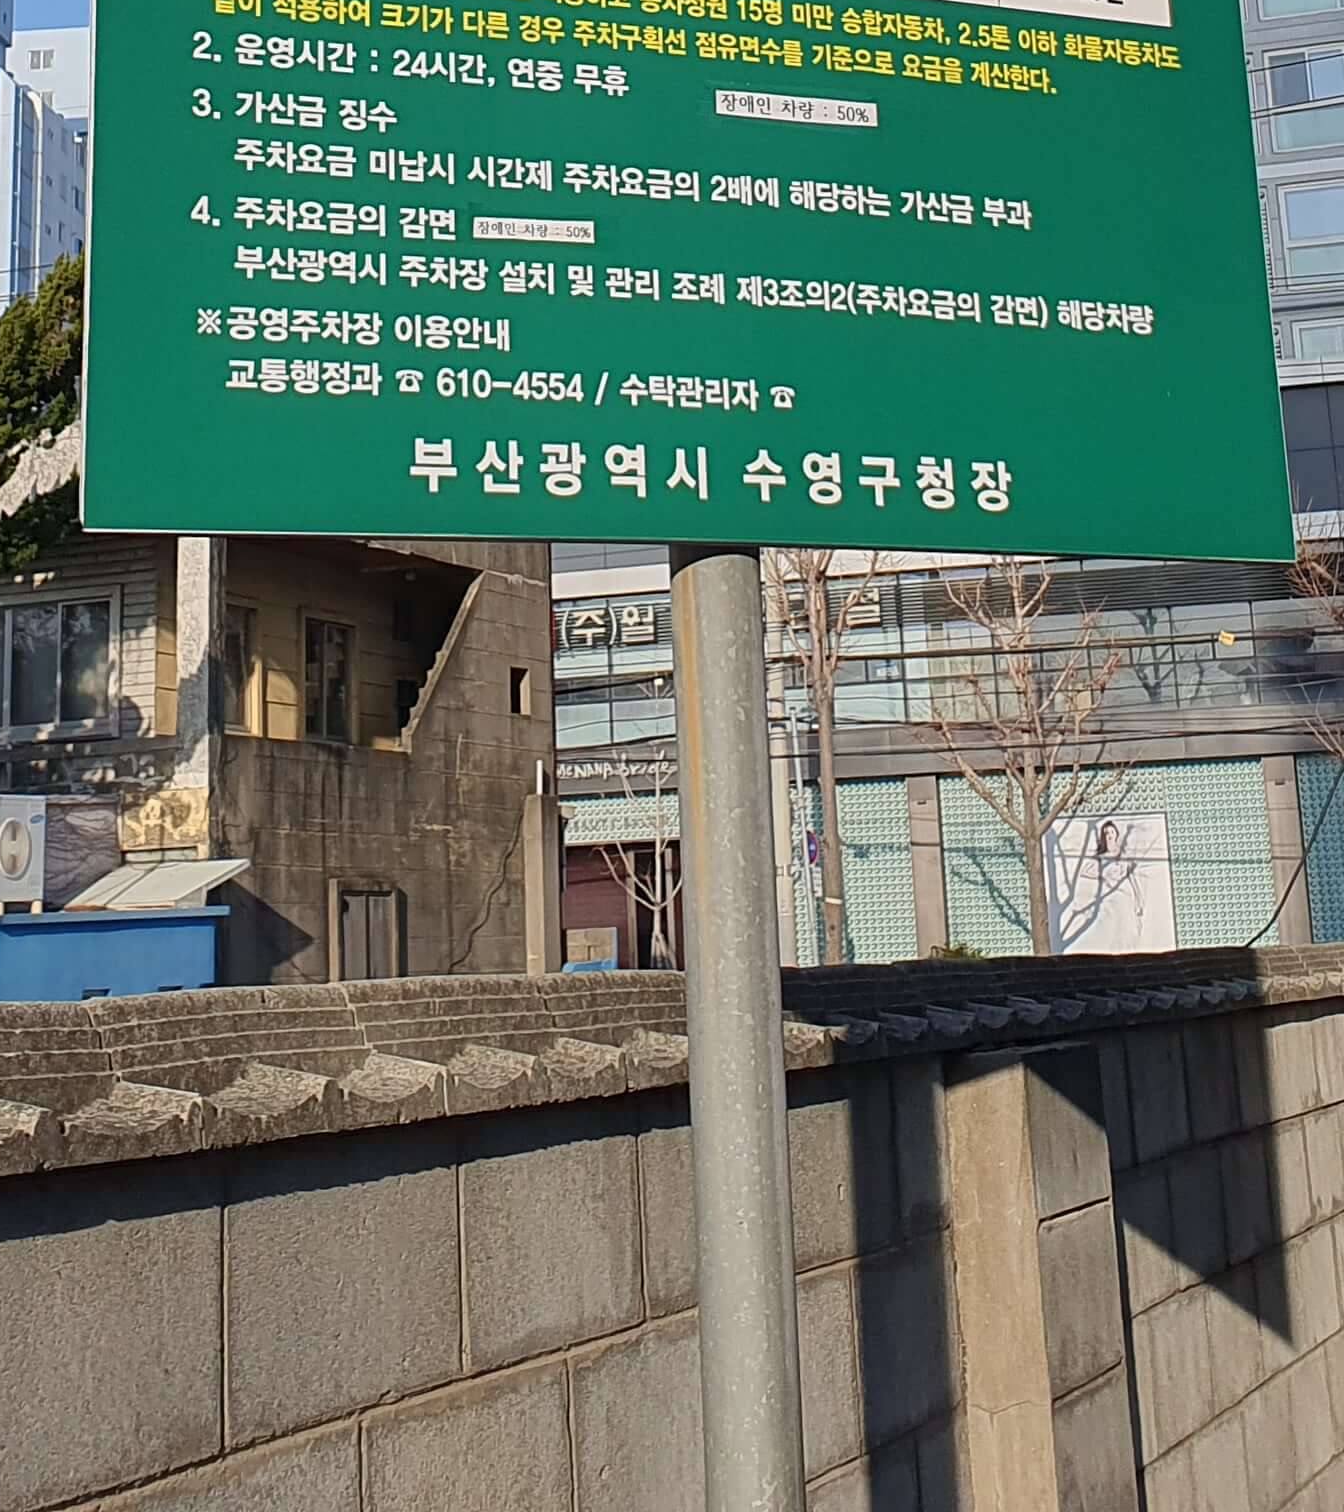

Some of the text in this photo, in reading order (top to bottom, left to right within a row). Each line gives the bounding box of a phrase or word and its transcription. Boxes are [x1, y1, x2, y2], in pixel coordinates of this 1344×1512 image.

[381, 4, 453, 34] 크기가
[463, 11, 509, 39] 다른
[520, 16, 564, 43] 경우
[574, 21, 686, 55] 주차구획선
[696, 32, 803, 66] 점유면수를
[813, 45, 895, 74] 기준으로
[903, 55, 963, 83] 요금을
[971, 62, 1056, 93] 계산한다.
[792, 4, 833, 30] 미만
[842, 8, 950, 45] 승합자동차,
[959, 23, 1010, 50] 2.5톤
[1019, 30, 1057, 56] 이하
[1065, 34, 1180, 68] 화물자동차도
[193, 32, 221, 61] 2.
[236, 34, 356, 73] 운영시간
[394, 50, 494, 86] 24시간,
[508, 59, 563, 91] 연중
[574, 65, 629, 96] 무휴
[192, 89, 397, 132] 3. 가산금 징수
[721, 93, 771, 116] 장애인
[781, 99, 815, 120] 차량
[837, 106, 869, 124] 50%
[235, 140, 1032, 229] 주차요금 미납시 시간제 주차요금의 2배에 해당하는 가산금 부과
[191, 196, 455, 240] 4. 주차요금의 감면
[566, 226, 591, 239] 50%
[235, 246, 386, 285] 부산광역시
[400, 256, 488, 290] 주차장
[500, 262, 554, 294] 설치
[568, 266, 593, 296] 및
[606, 268, 659, 300] 관리
[672, 273, 725, 304] 조례
[991, 296, 1048, 328] 감면)
[1057, 301, 1153, 334] 해당차량
[395, 315, 509, 351] 이용안내
[226, 359, 759, 411] 교통행정과 610-4554 / 수탁관리자
